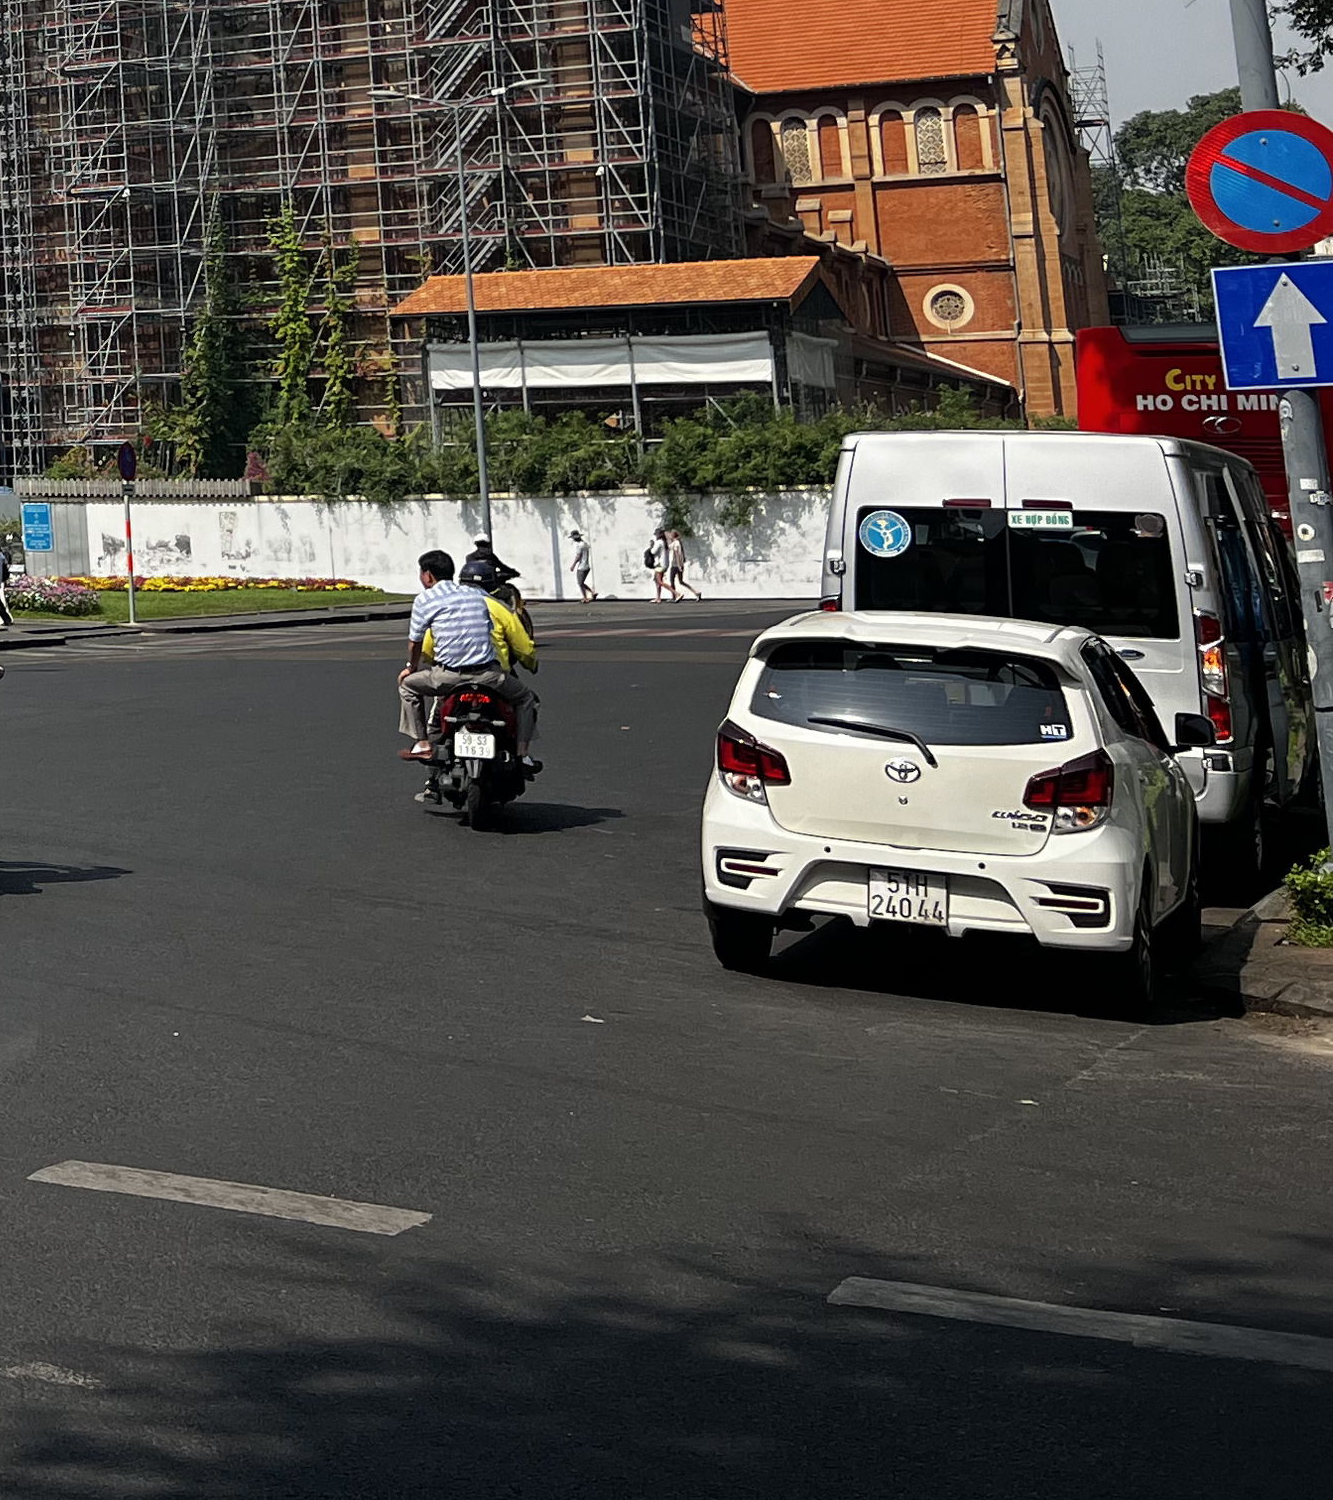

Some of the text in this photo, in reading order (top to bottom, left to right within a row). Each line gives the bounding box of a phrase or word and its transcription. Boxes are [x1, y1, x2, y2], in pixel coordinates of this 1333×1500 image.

[1136, 394, 1174, 412] HO
[1181, 394, 1228, 412] CHI
[1011, 514, 1022, 525] XE
[887, 872, 928, 897] 51H
[872, 894, 944, 922] 240.44
